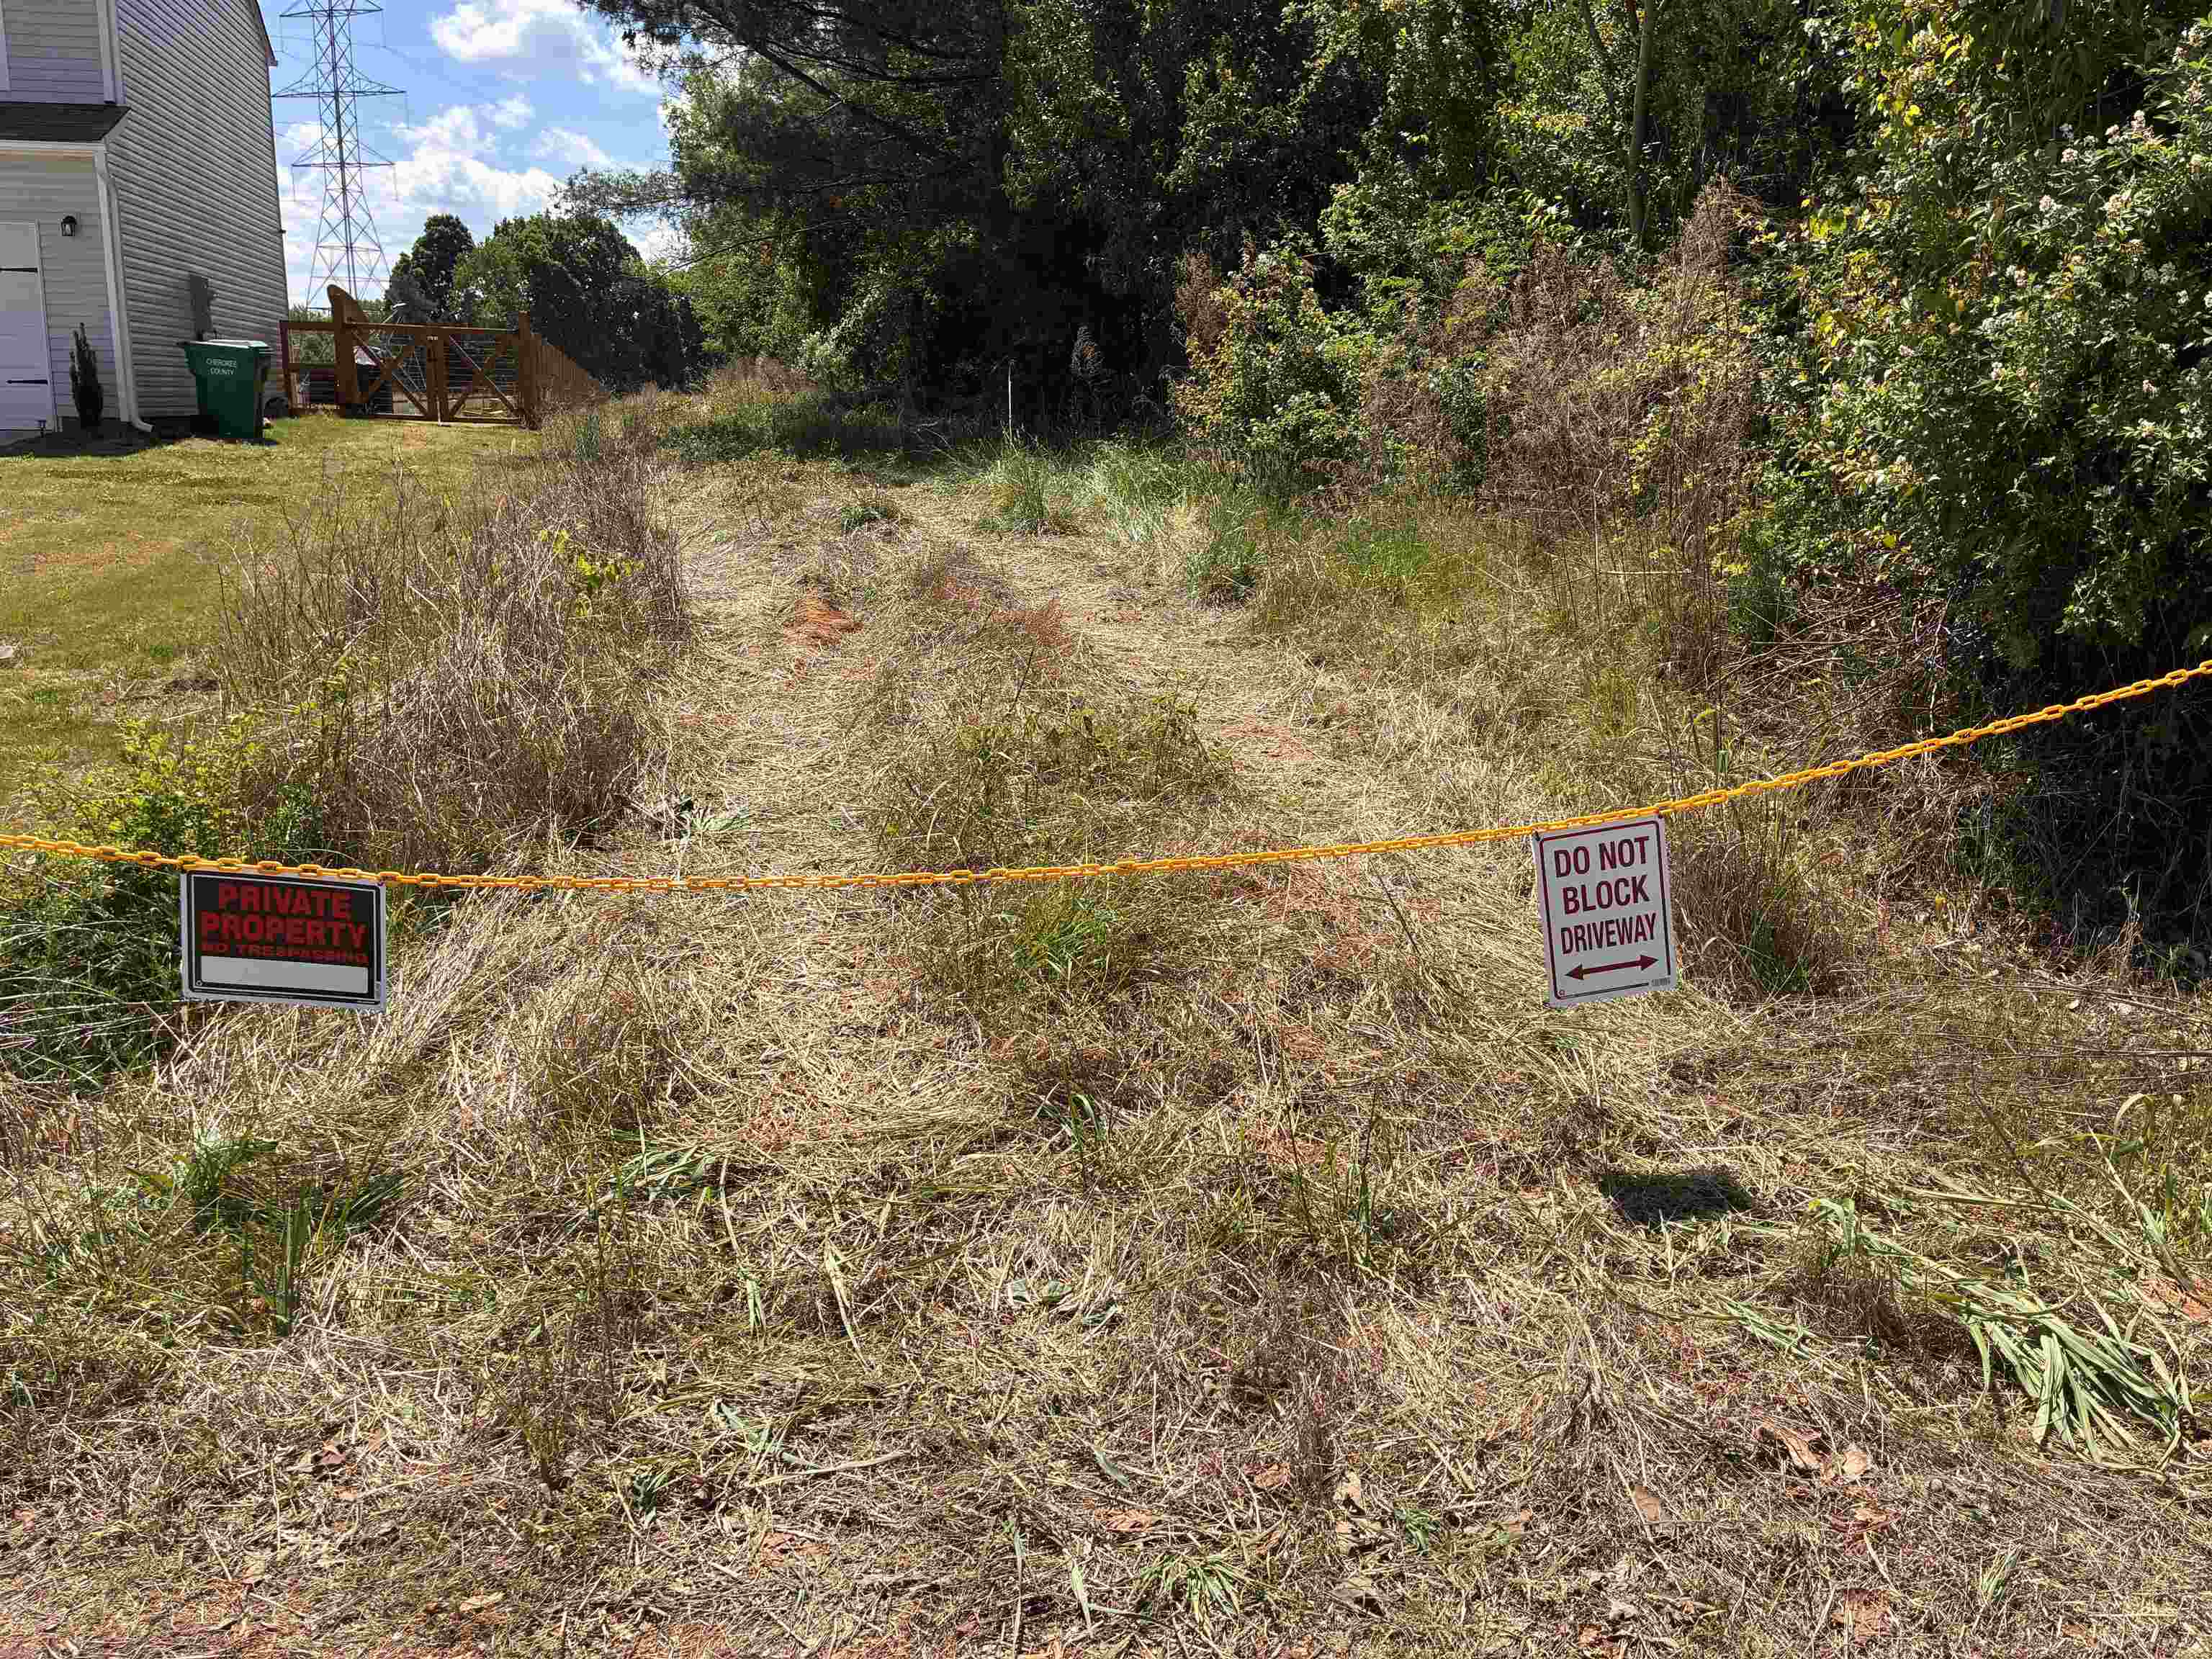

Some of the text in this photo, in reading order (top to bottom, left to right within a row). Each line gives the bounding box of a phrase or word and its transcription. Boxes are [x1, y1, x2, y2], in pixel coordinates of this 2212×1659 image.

[1554, 836, 1650, 878] DO NOT
[218, 883, 351, 919] PRIVATE
[1563, 874, 1650, 915] BLOCK
[201, 910, 367, 947] PROPERTY
[1560, 912, 1656, 955] DRIVEWAY
